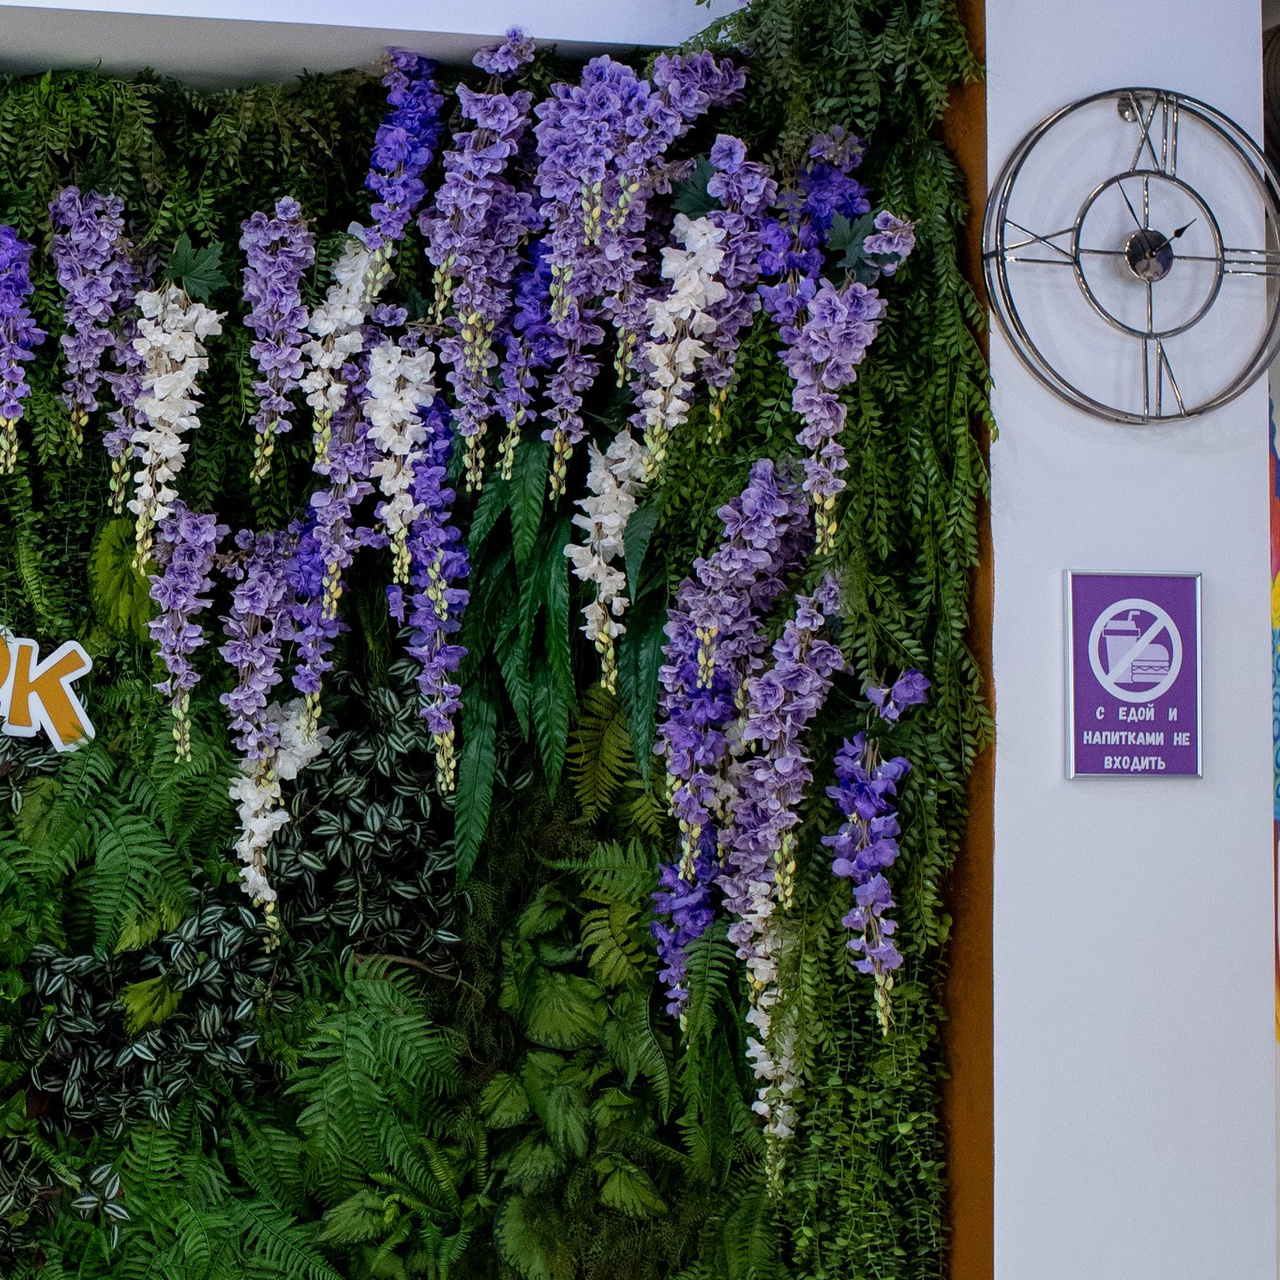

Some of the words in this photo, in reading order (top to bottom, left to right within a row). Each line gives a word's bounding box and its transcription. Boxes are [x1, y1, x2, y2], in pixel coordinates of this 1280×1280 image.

[1095, 706, 1105, 720] С
[1118, 703, 1155, 723] ЕДОЙ
[1168, 707, 1178, 721] И
[1083, 730, 1165, 746] НАПИТКАМИ
[1173, 732, 1191, 746] НЕ
[1104, 755, 1166, 772] ВХОДИТЬ
